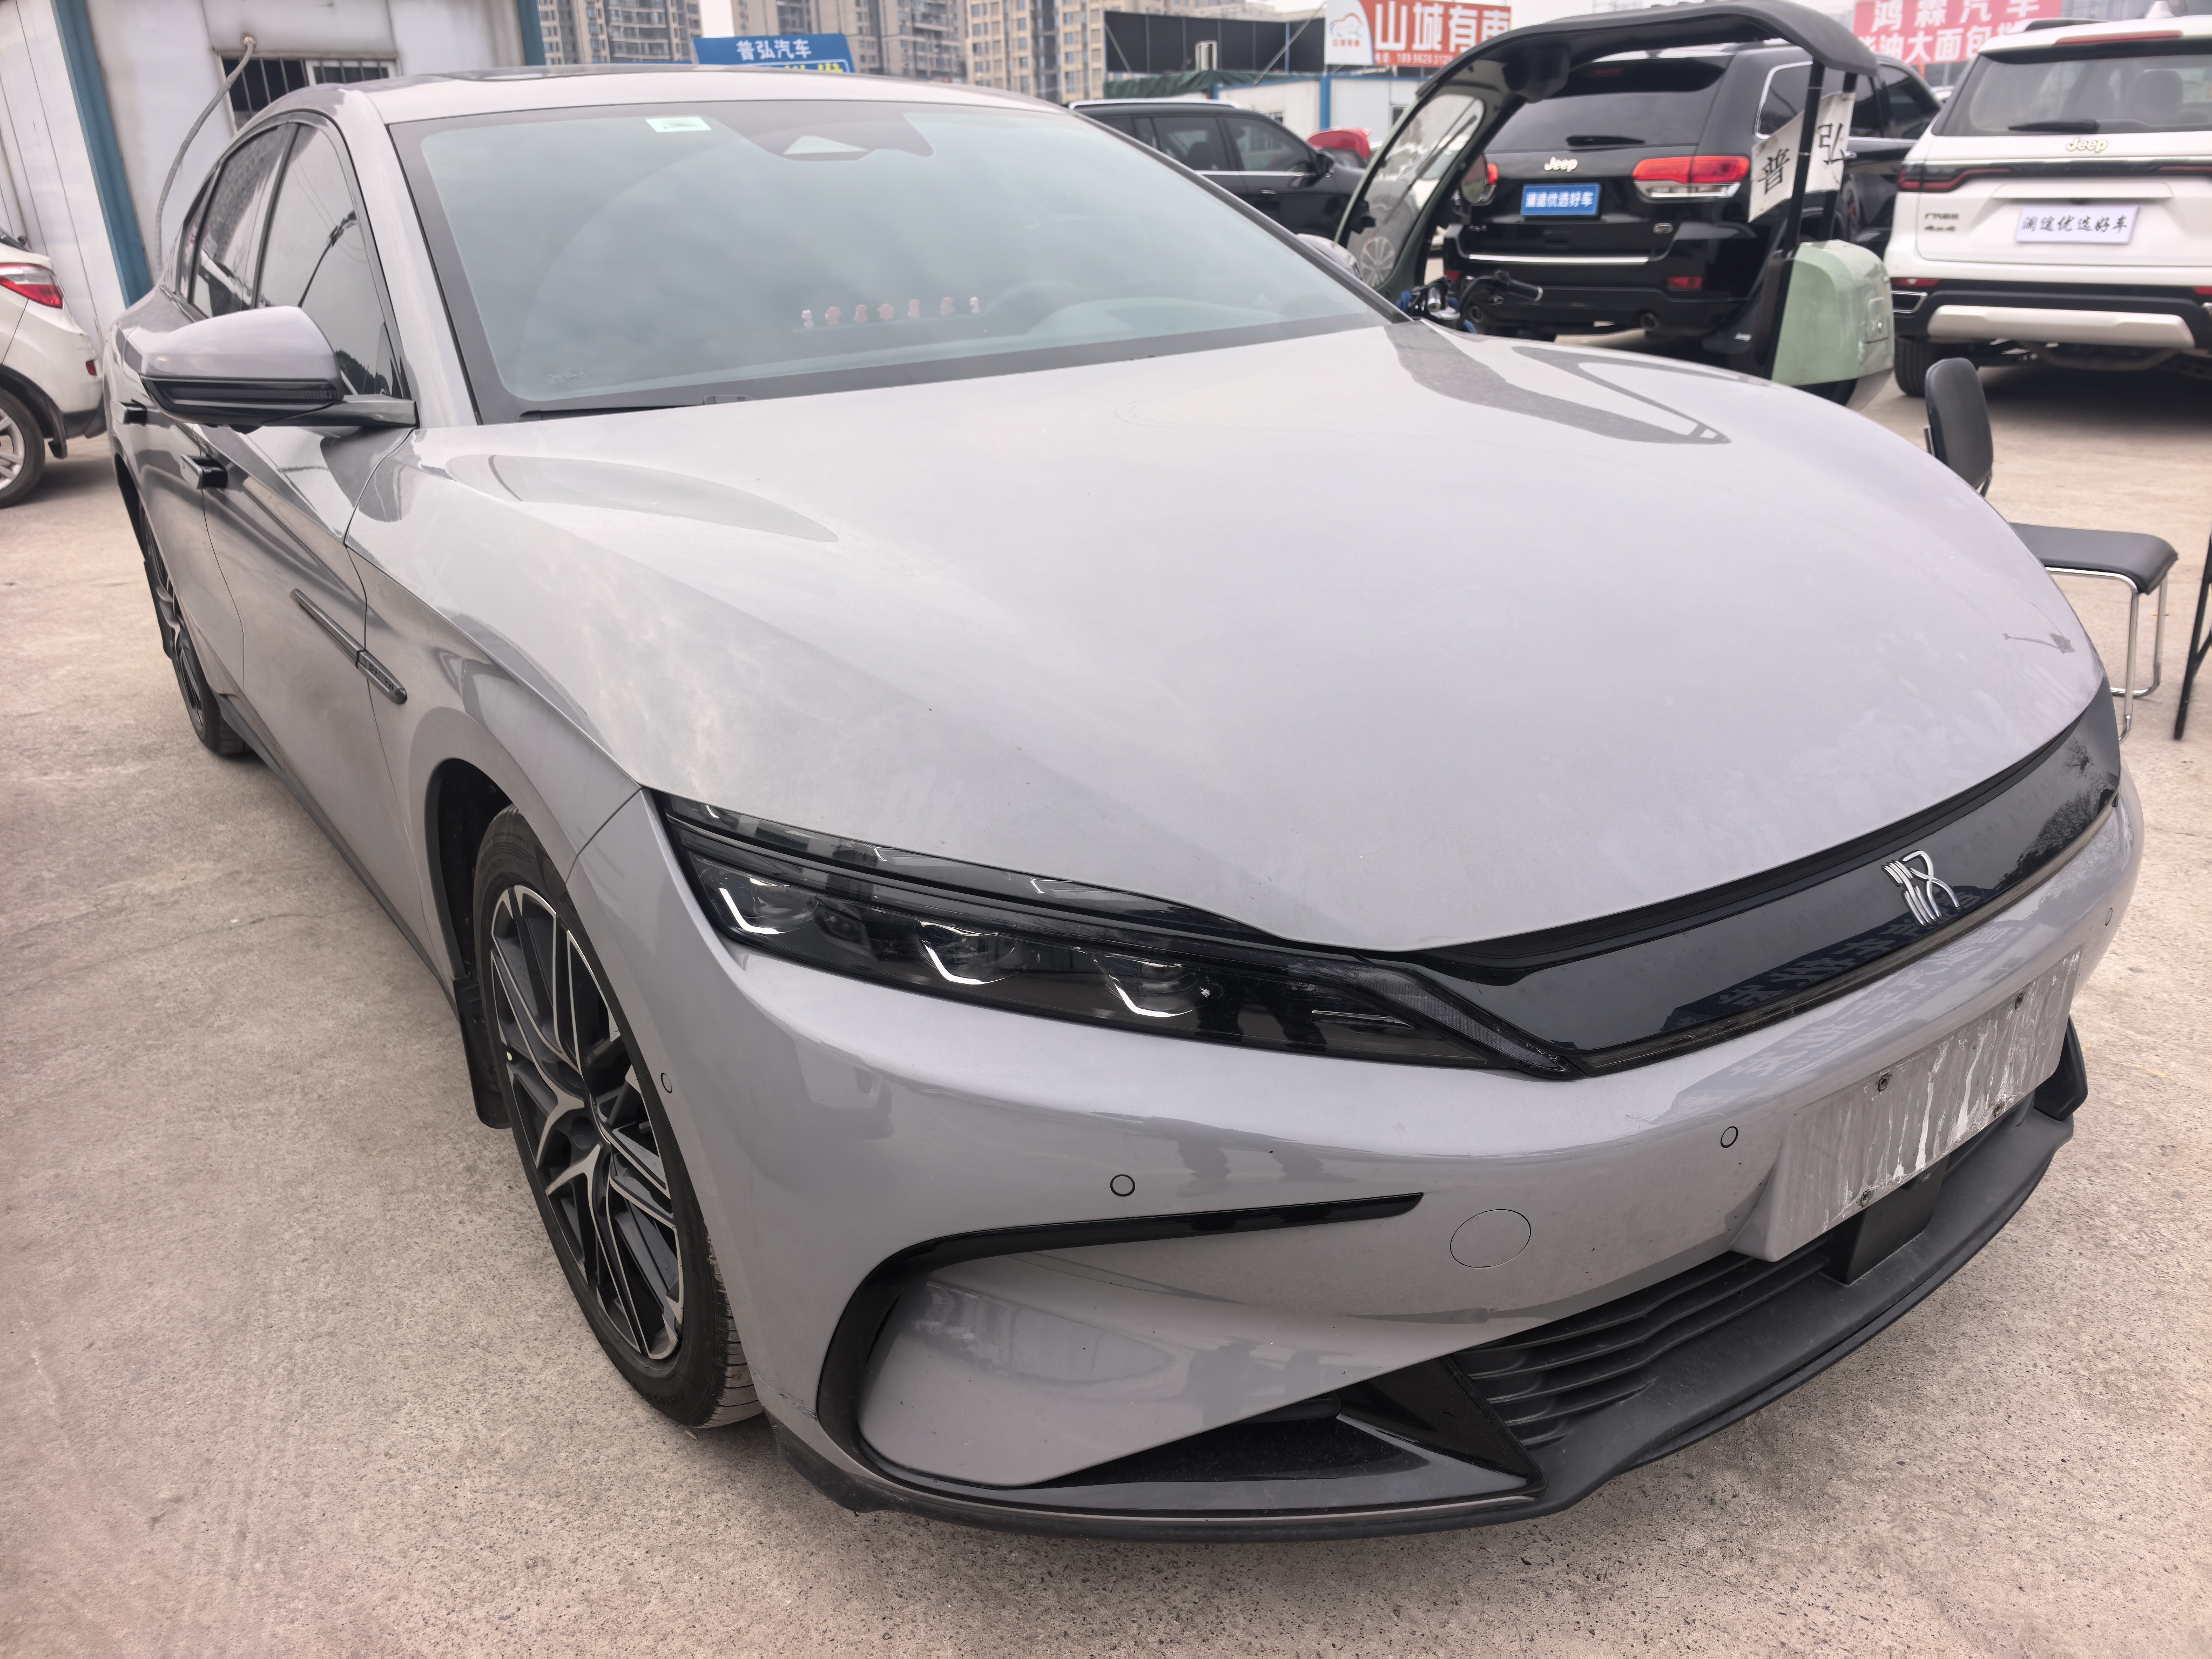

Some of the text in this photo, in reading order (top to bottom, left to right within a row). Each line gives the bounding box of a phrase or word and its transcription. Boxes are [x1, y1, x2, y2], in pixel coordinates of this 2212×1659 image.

[736, 38, 812, 60] 普弘汽车
[2066, 137, 2108, 153] Jeep
[1544, 157, 1578, 172] Jeep
